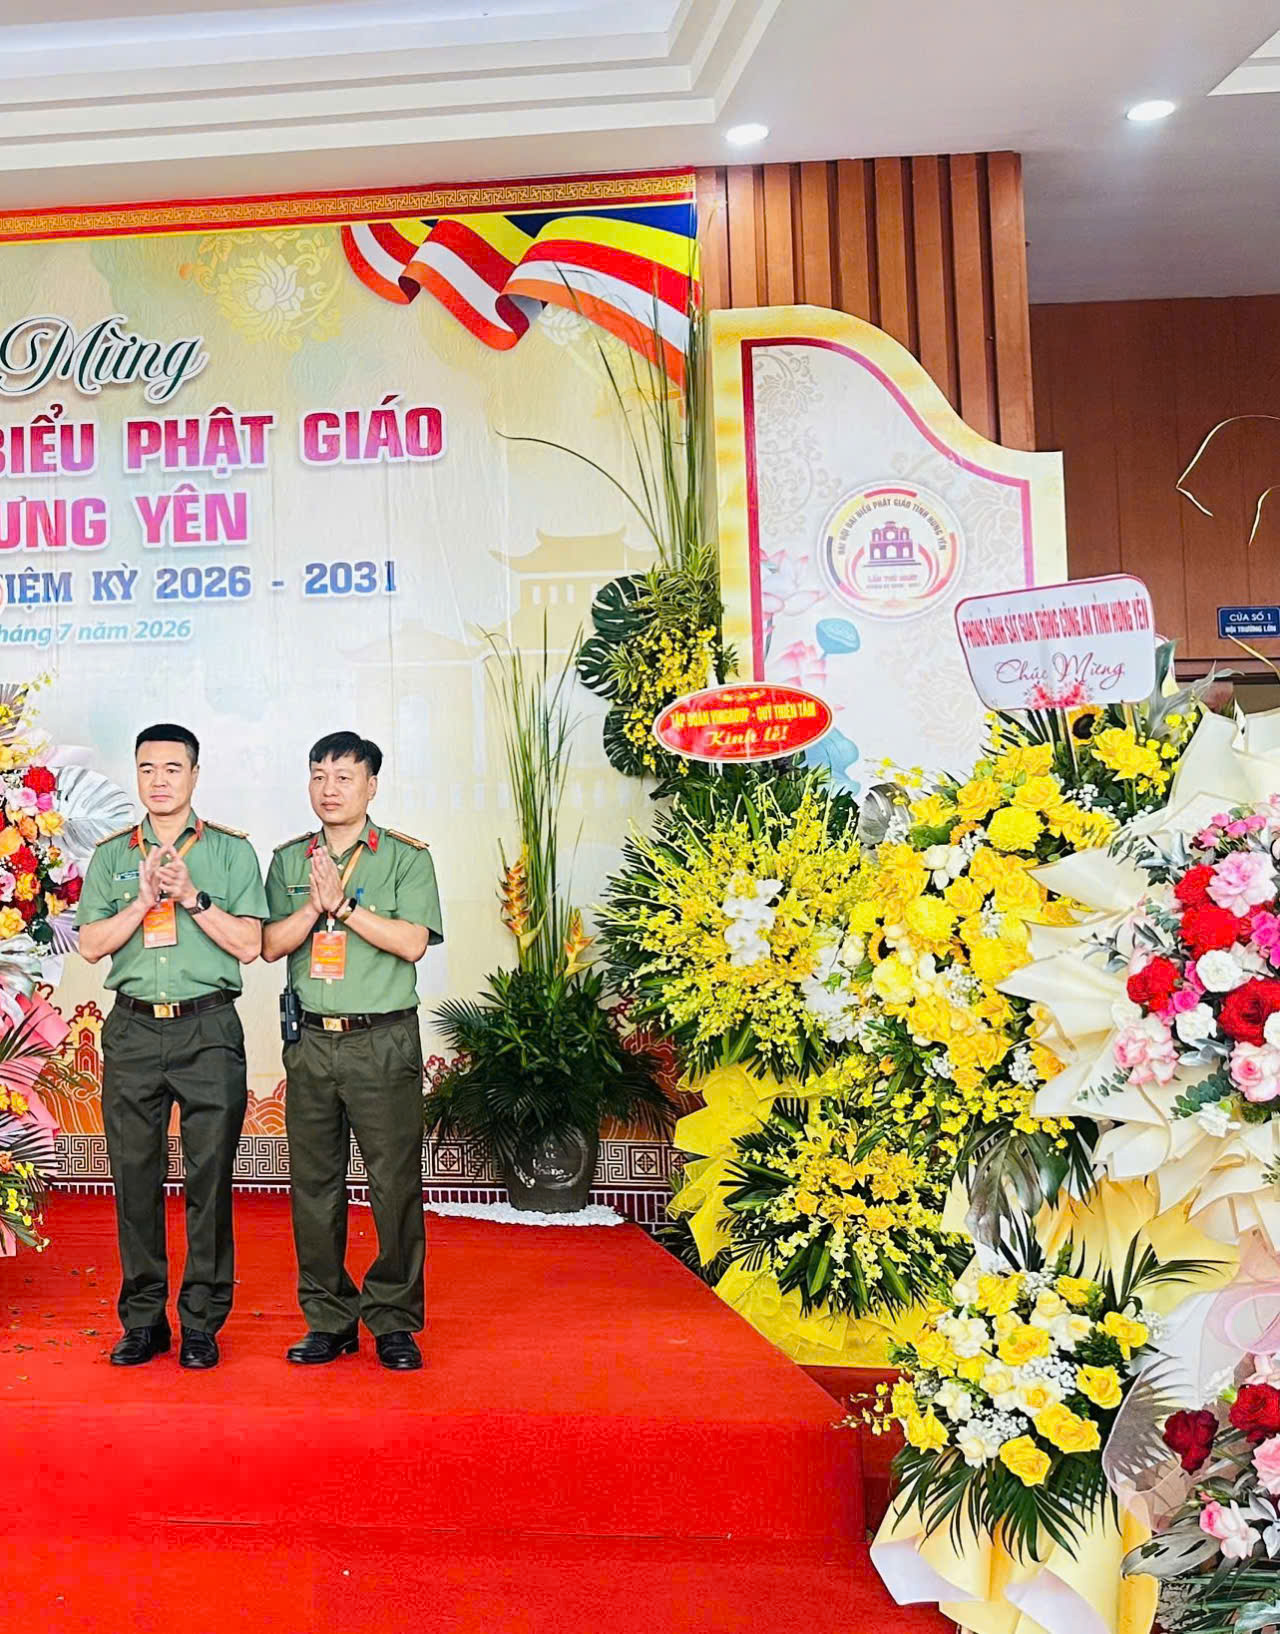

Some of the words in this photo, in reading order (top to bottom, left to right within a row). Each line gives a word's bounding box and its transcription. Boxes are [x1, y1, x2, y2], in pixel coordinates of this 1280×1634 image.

[126, 406, 273, 474] PHẬT
[303, 394, 443, 462] GIÁO
[134, 483, 248, 544] YÊN
[92, 562, 138, 602] KỲ
[155, 565, 252, 599] 2026
[304, 560, 397, 595] 2031
[58, 623, 72, 642] 7
[78, 621, 129, 641] năm
[135, 619, 191, 639] 2026
[1229, 611, 1250, 622] CỬA
[1251, 610, 1265, 621] SỐ
[1267, 613, 1272, 621] 1
[994, 658, 1049, 684] Chúc
